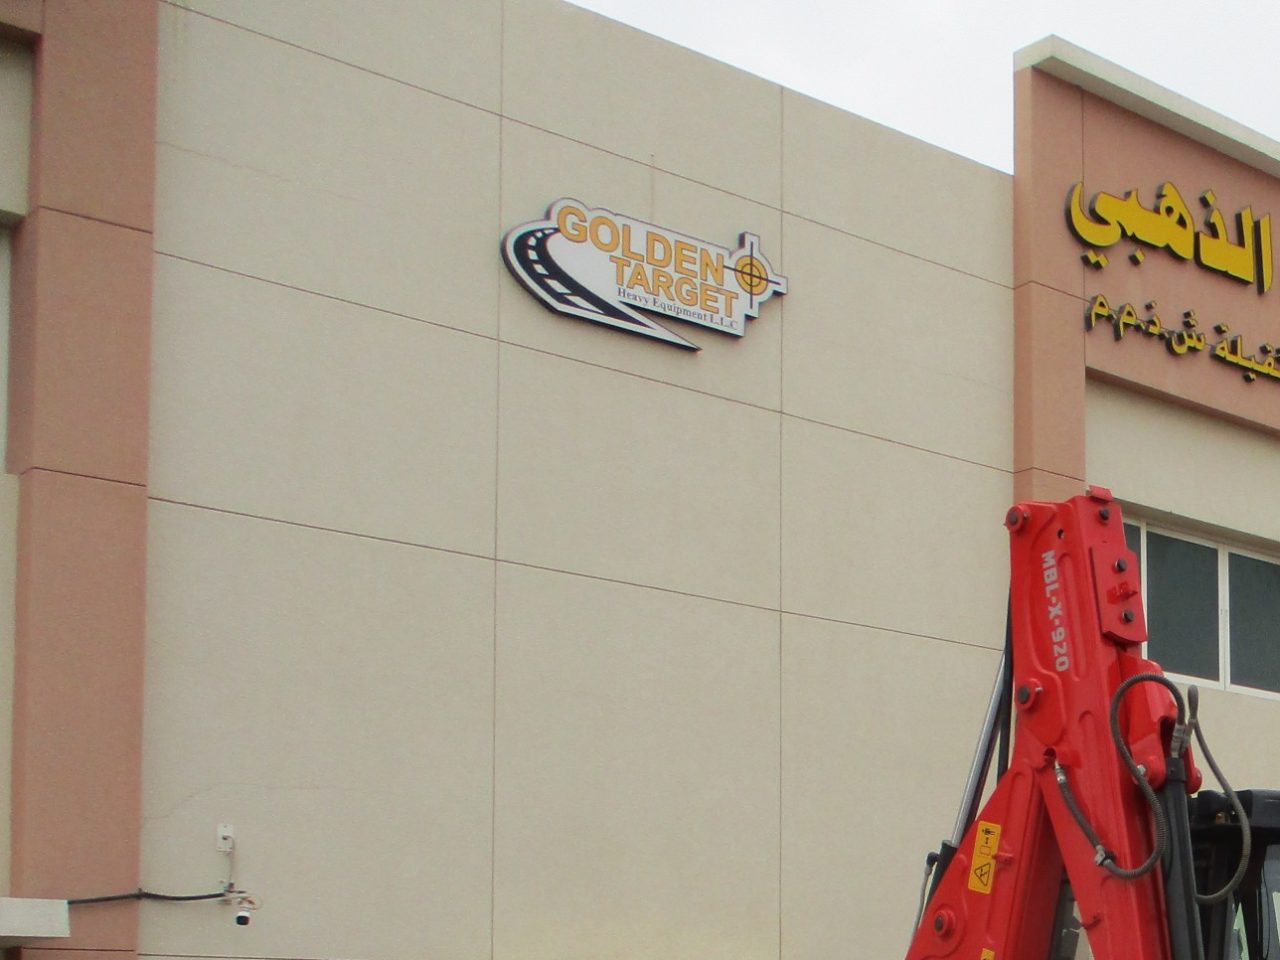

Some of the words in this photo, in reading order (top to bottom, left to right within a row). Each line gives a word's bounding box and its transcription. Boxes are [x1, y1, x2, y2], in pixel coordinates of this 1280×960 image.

[556, 204, 724, 287] GOLDEN
[1065, 181, 1273, 295] الذهبي
[609, 255, 739, 318] TARGET
[617, 287, 649, 305] Heavy
[653, 297, 707, 321] Equipment
[1041, 550, 1070, 672] MBL-X-920
